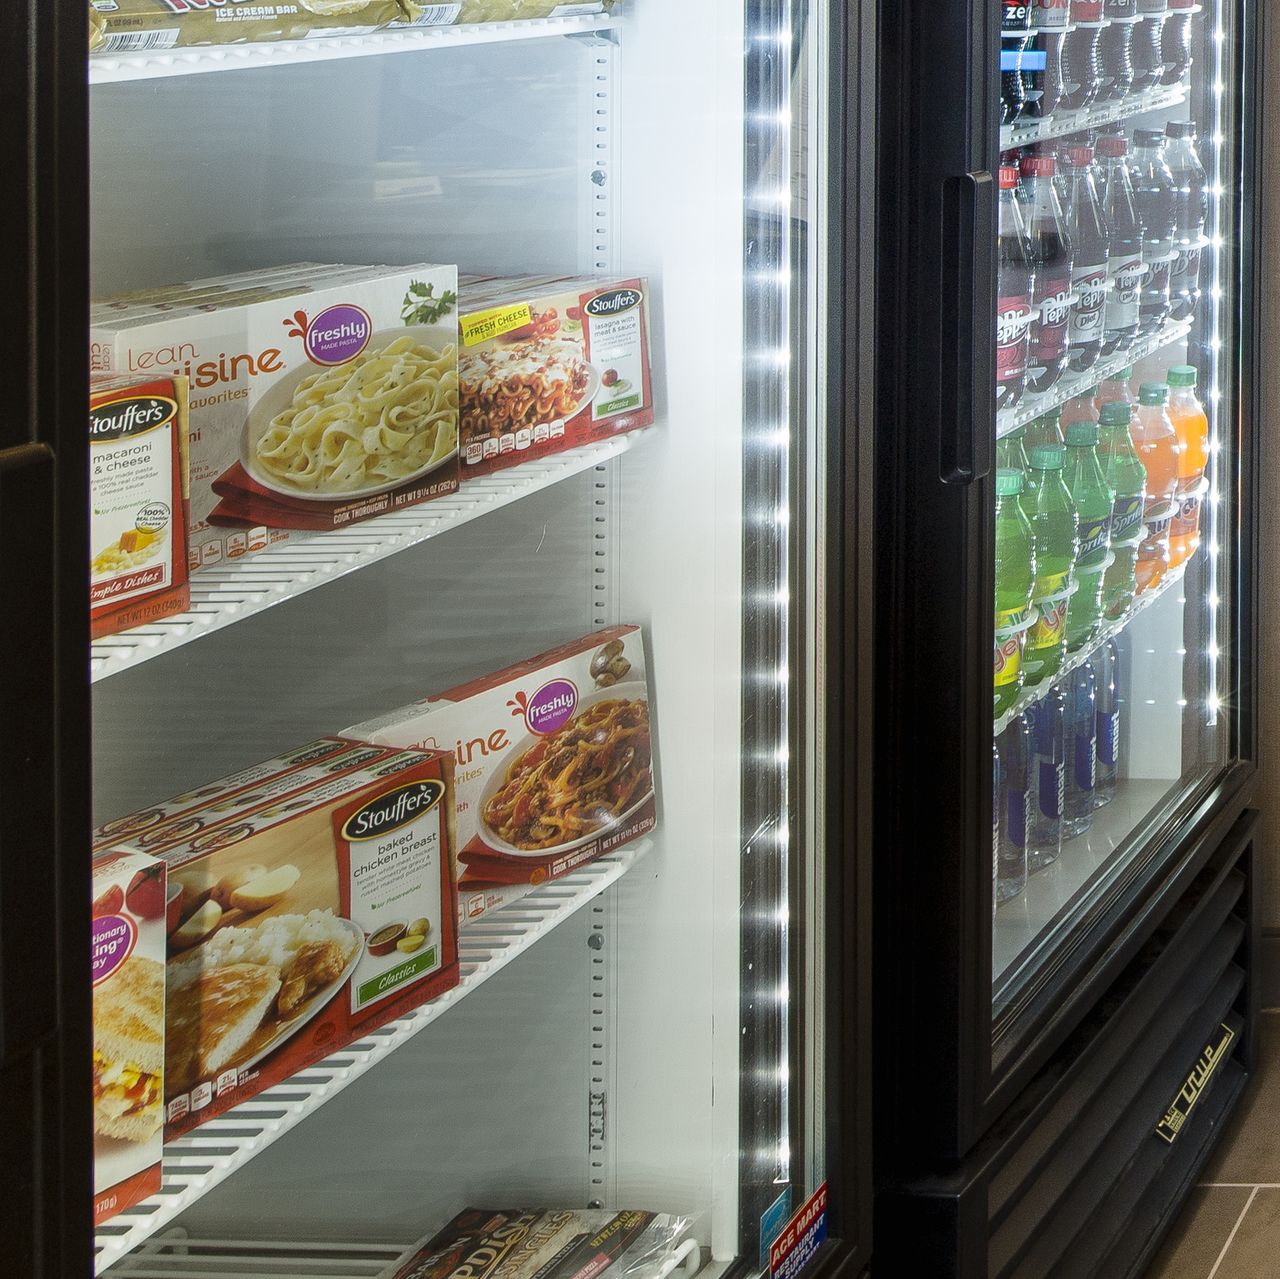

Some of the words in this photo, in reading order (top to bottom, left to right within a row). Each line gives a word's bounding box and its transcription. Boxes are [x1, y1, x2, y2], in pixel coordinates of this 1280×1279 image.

[215, 7, 234, 18] ICE
[235, 6, 274, 18] CREAM
[275, 4, 298, 15] BAR
[592, 291, 636, 314] Stouffer's
[469, 321, 497, 338] FRESH
[498, 307, 529, 325] CHEESE
[593, 326, 611, 338] meat
[617, 322, 637, 335] sauce
[621, 315, 636, 326] with
[1080, 312, 1098, 327] Diet
[310, 321, 367, 348] freshly
[320, 341, 338, 351] MADE
[339, 337, 358, 348] PASTA
[127, 341, 200, 372] lean
[93, 441, 152, 464] macaroni
[94, 464, 103, 475] &
[106, 453, 152, 472] cheese
[142, 507, 165, 517] 100%
[395, 494, 407, 506] NET
[333, 512, 351, 525] COOK
[351, 500, 389, 519] THOROUGHLY
[529, 692, 575, 723] freshly
[355, 786, 433, 835] Stouffer's
[352, 851, 399, 878] chicken
[400, 832, 438, 857] breast
[377, 831, 415, 856] baked
[378, 963, 417, 991] Classics
[772, 1228, 795, 1266] ACE
[796, 1190, 827, 1236] MART
